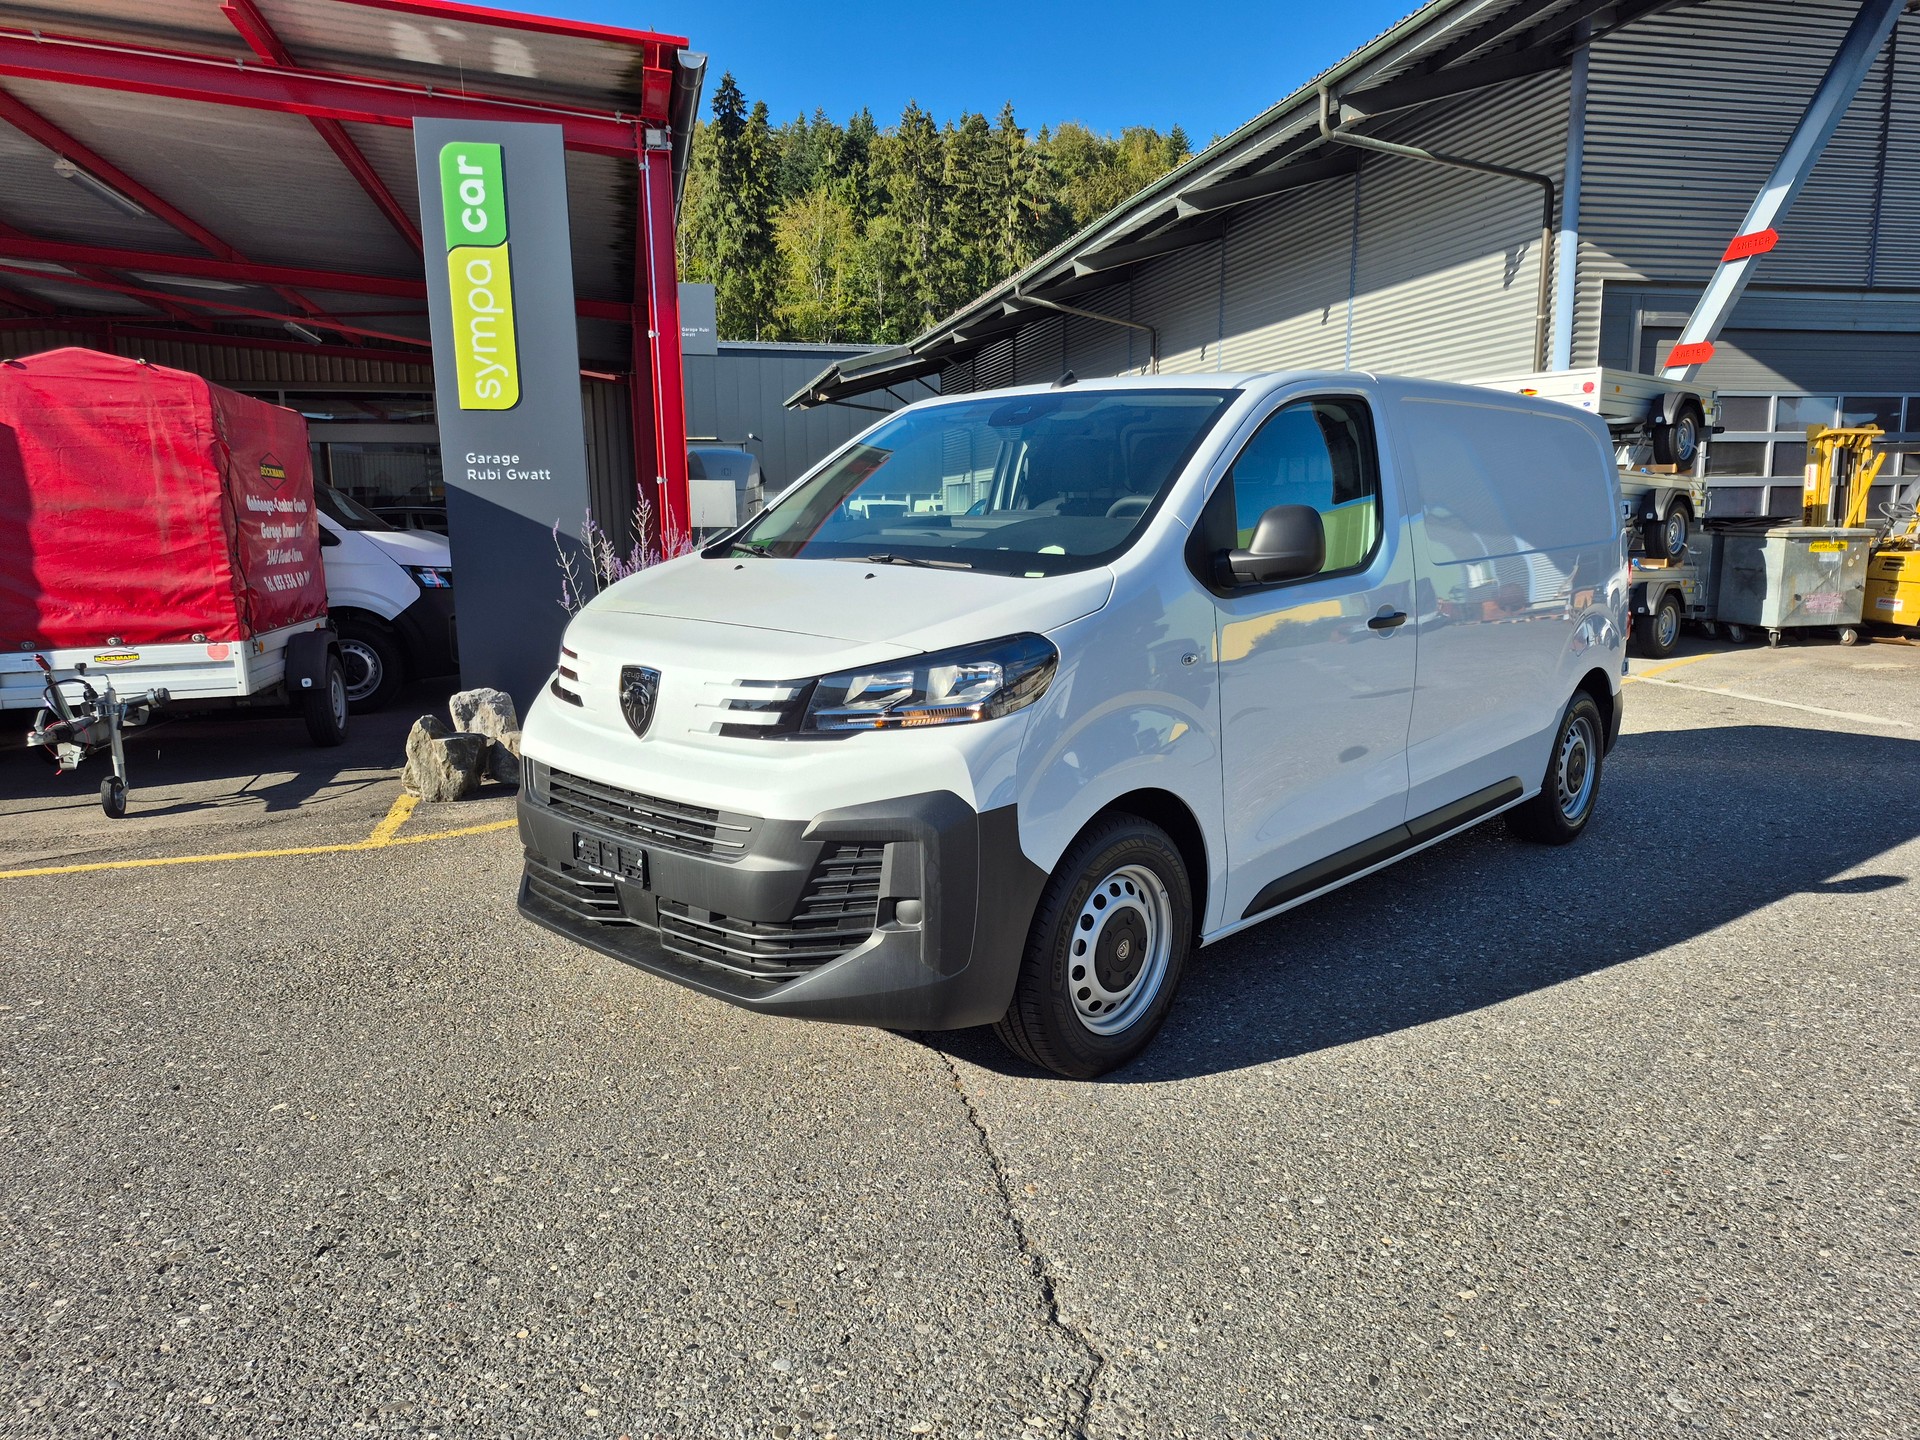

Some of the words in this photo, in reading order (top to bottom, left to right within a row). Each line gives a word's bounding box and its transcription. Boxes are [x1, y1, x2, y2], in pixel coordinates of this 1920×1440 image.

[457, 154, 489, 234] car
[466, 258, 509, 400] sympa
[465, 452, 520, 466] Garage
[467, 468, 501, 480] Rubi
[506, 468, 551, 480] Gwatt
[94, 653, 140, 662] BÖCKMANN
[622, 671, 656, 682] PEUGEOT
